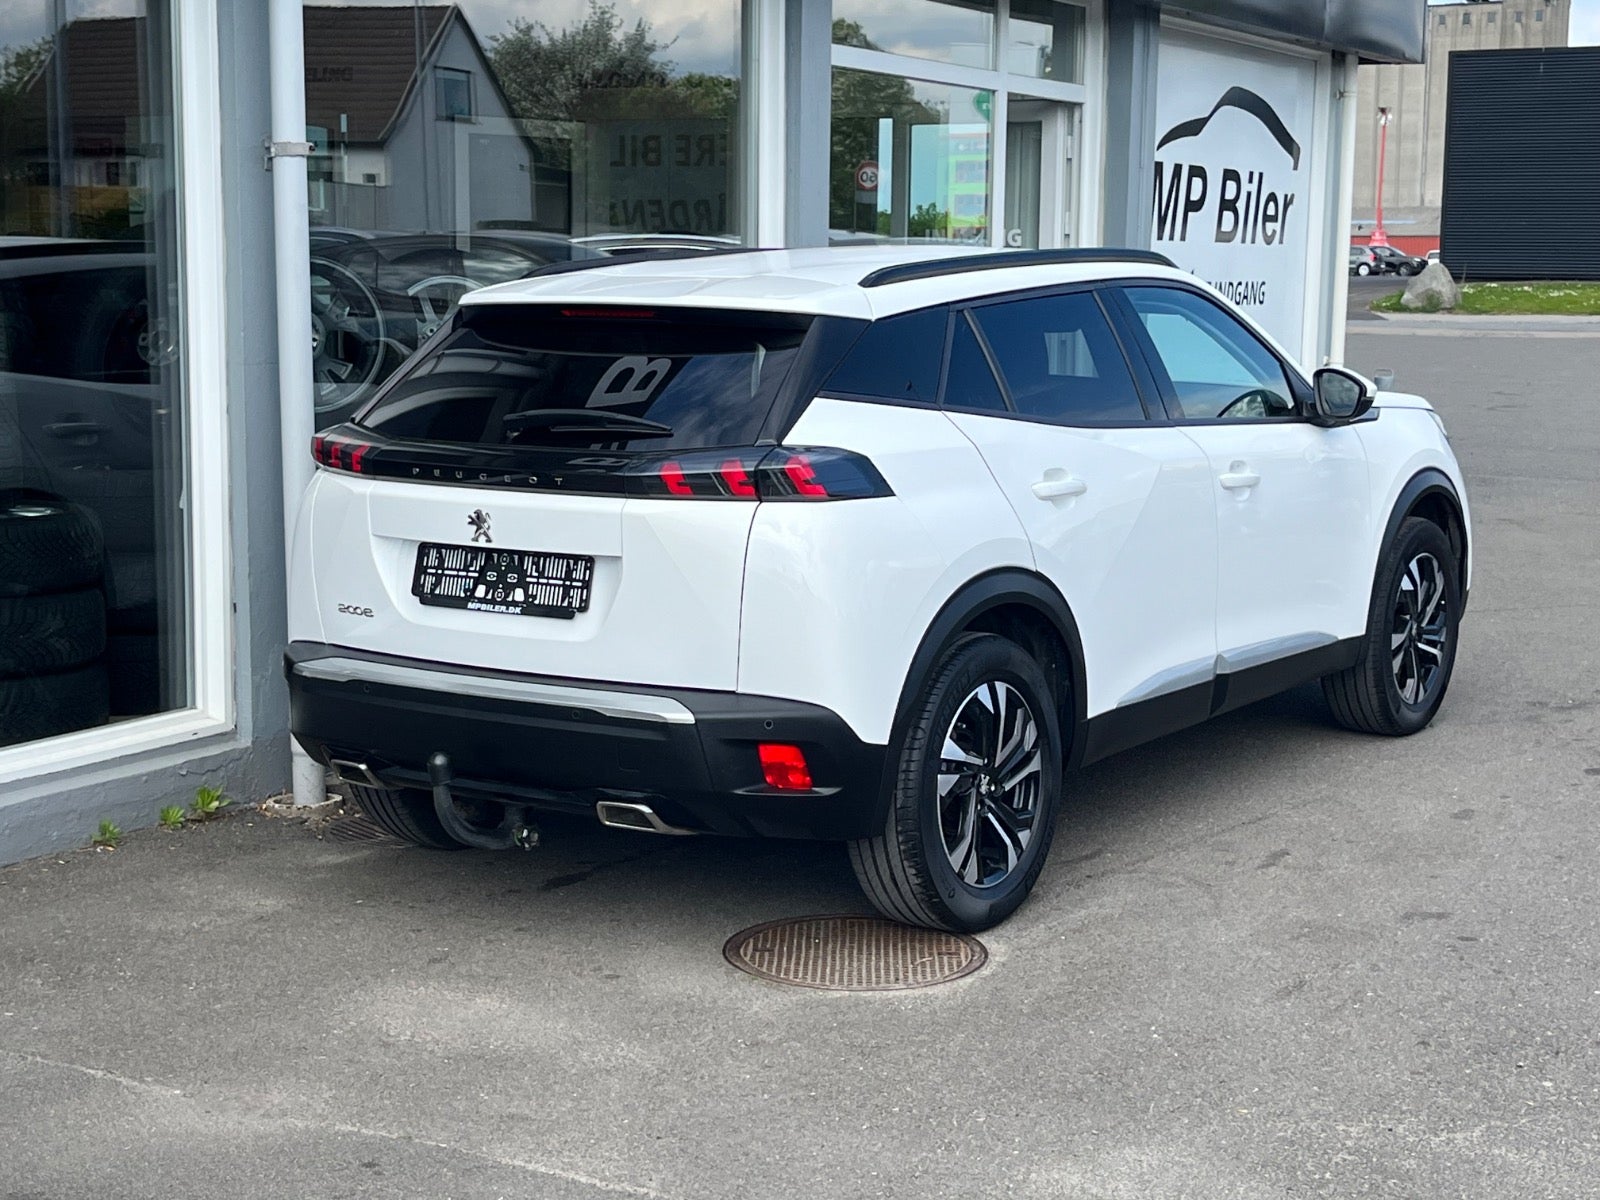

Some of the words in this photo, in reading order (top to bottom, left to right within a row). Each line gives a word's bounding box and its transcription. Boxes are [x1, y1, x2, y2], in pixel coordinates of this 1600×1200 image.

[1151, 161, 1208, 242] MP
[1214, 167, 1295, 246] Biler
[412, 467, 563, 486] PEUGEOT
[467, 601, 523, 615] MPBILER.DK
